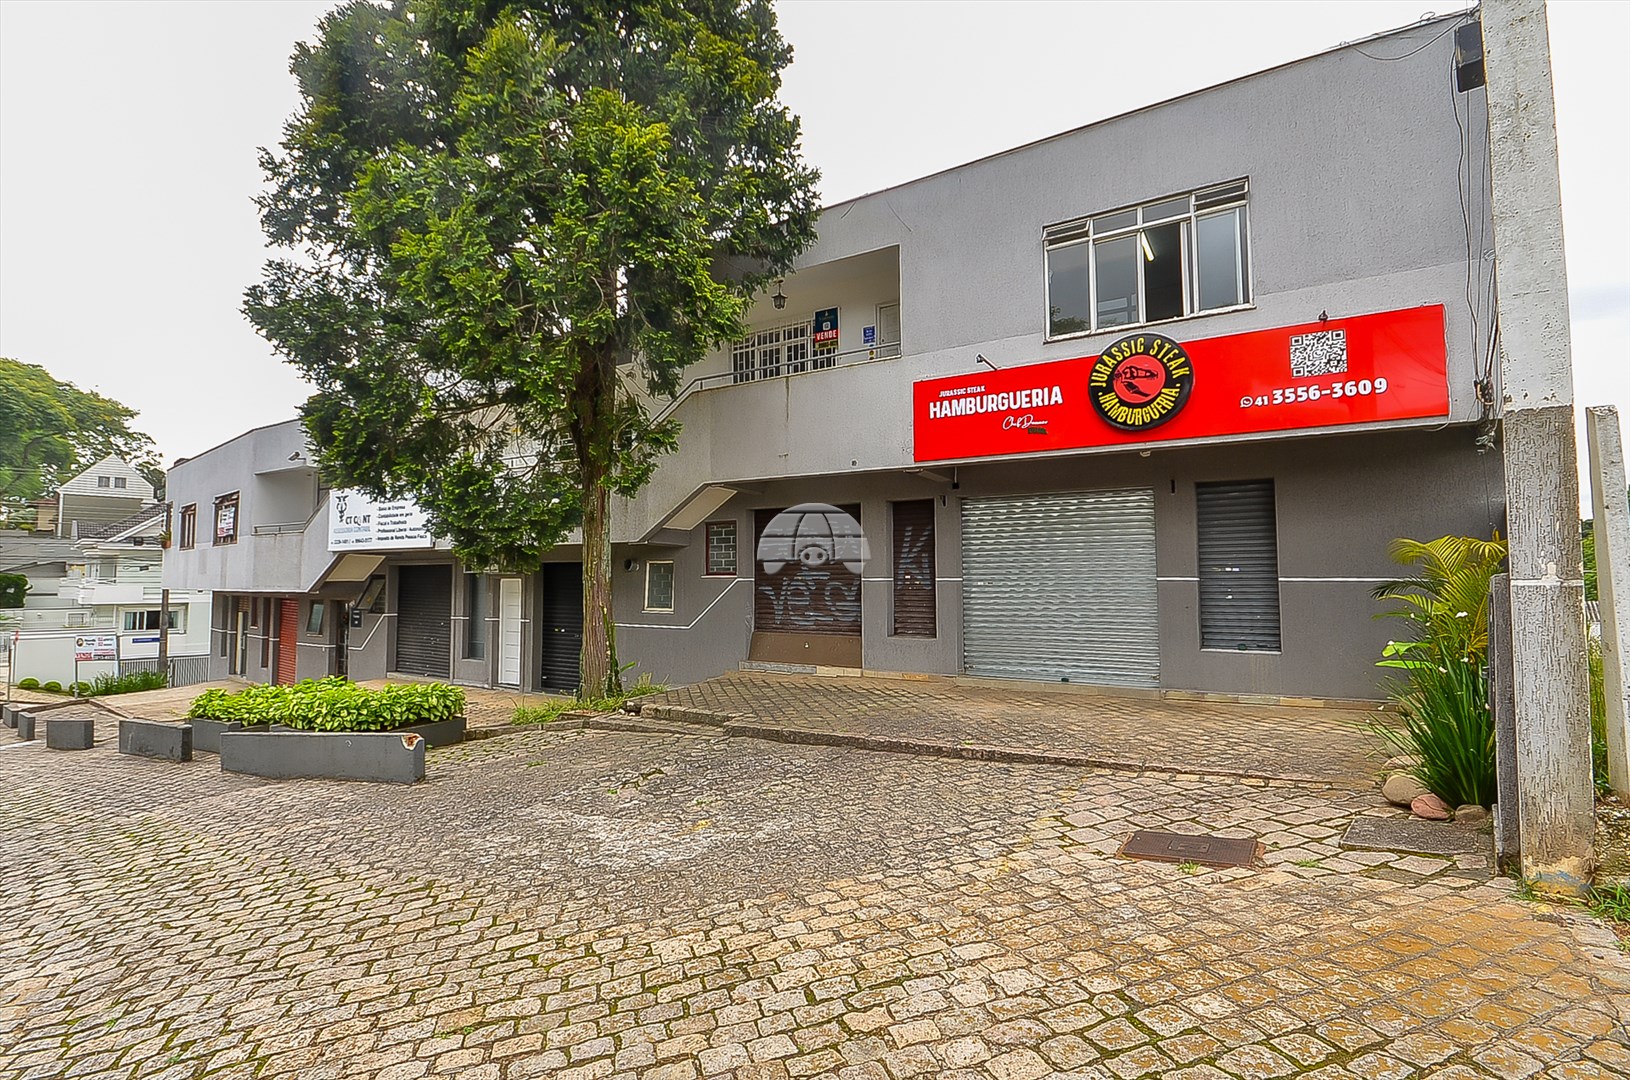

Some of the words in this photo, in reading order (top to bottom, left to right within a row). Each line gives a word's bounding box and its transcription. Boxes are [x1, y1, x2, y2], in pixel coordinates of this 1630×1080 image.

[816, 330, 837, 340] VENDE
[1090, 338, 1145, 388] JURASSIC
[1149, 339, 1190, 379] STEAK
[929, 385, 1064, 420] HAMBURGUERIA
[938, 388, 966, 398] JURASSIC
[967, 385, 986, 394] STEAK
[1254, 396, 1270, 406] 41
[1272, 377, 1388, 405] 3556-3609
[1098, 388, 1180, 426] HAMBURGUERIA
[345, 516, 352, 525] CT
